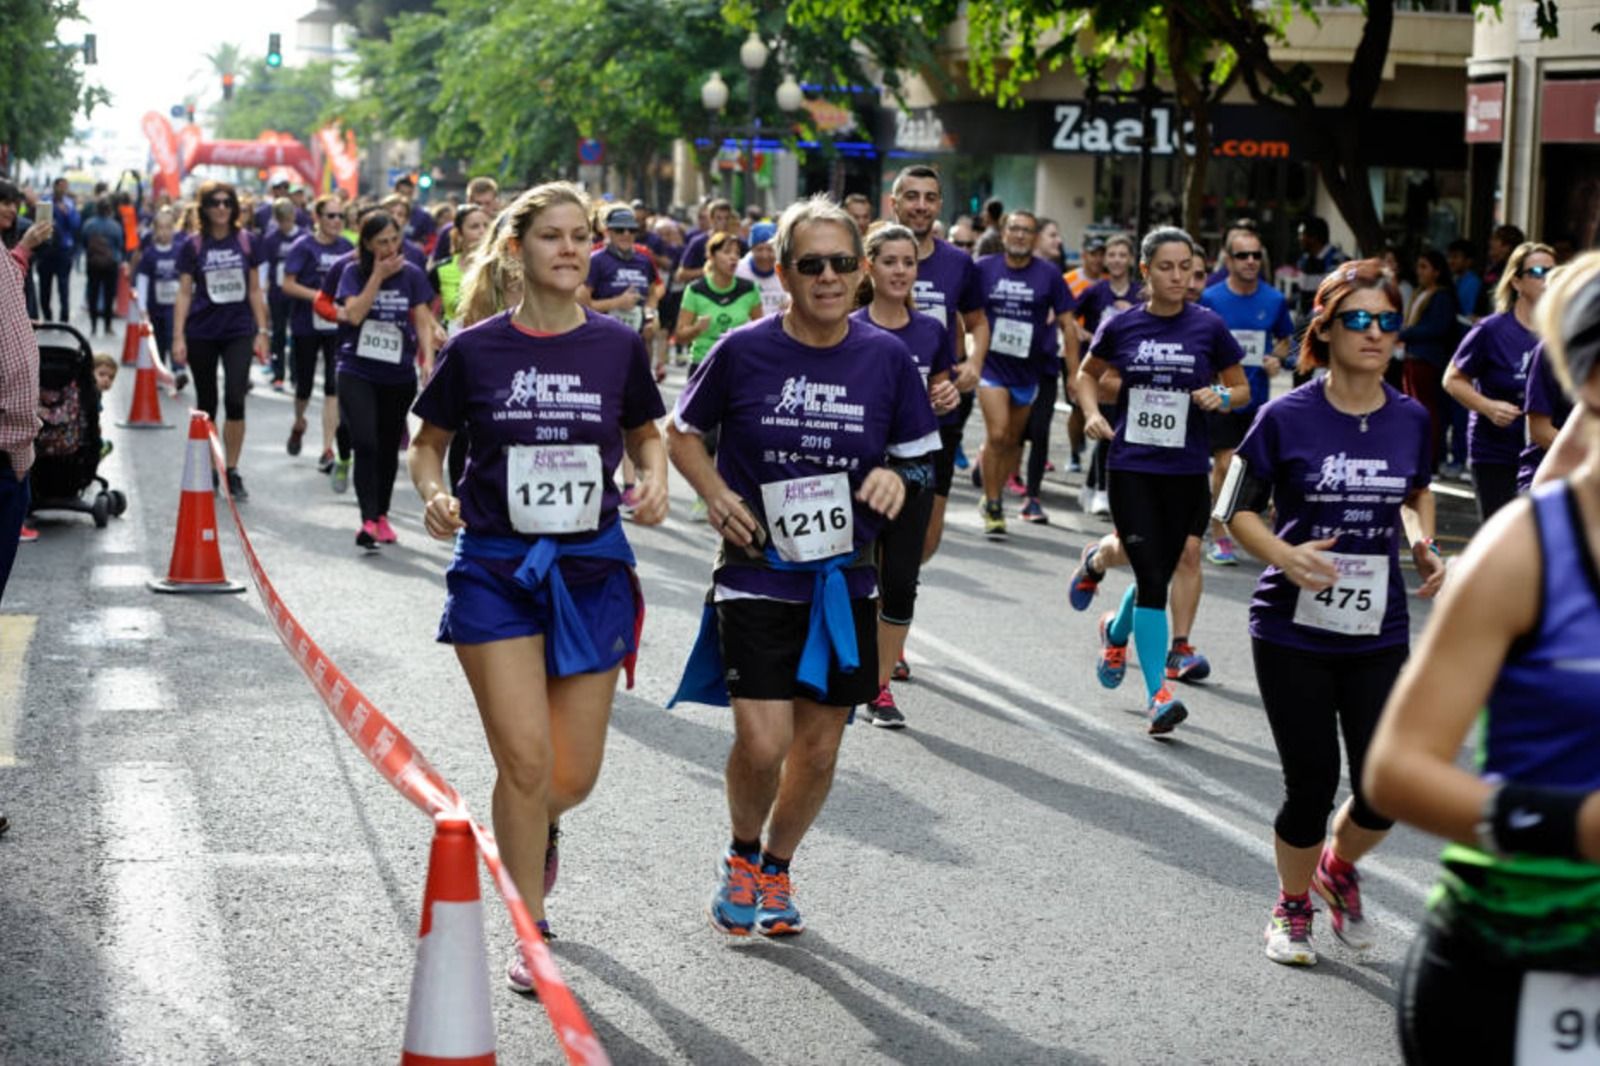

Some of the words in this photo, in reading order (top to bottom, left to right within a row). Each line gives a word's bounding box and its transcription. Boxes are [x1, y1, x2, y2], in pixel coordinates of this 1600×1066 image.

[1137, 411, 1176, 430] 880
[536, 426, 568, 440] 2016
[801, 435, 832, 449] 2016
[516, 481, 596, 506] 1217
[775, 506, 847, 538] 1216
[1343, 509, 1374, 522] 2016
[1314, 585, 1371, 611] 475
